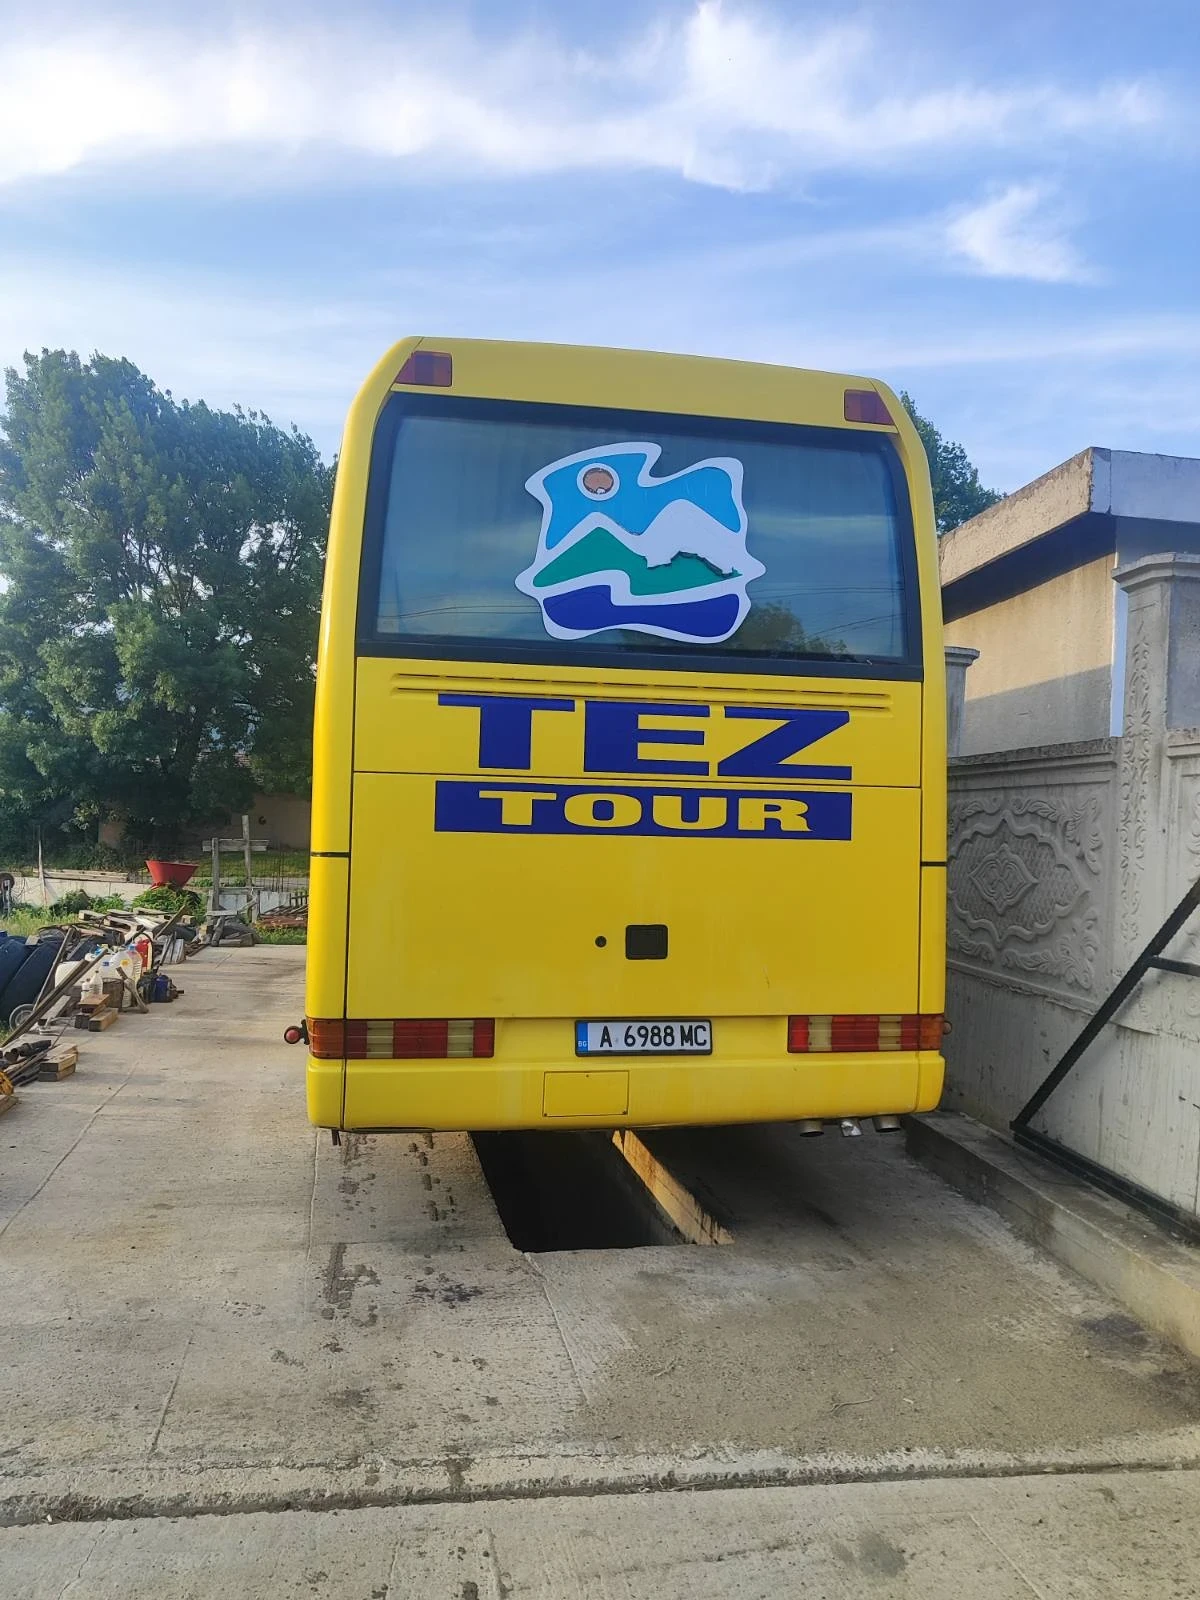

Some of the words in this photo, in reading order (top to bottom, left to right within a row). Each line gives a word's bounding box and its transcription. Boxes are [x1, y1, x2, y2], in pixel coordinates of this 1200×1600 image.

[438, 693, 852, 781] TEZ
[479, 790, 812, 831] TOUR
[577, 1040, 588, 1048] BG
[600, 1025, 612, 1047] A
[624, 1025, 675, 1047] 6988
[680, 1025, 707, 1047] MC
